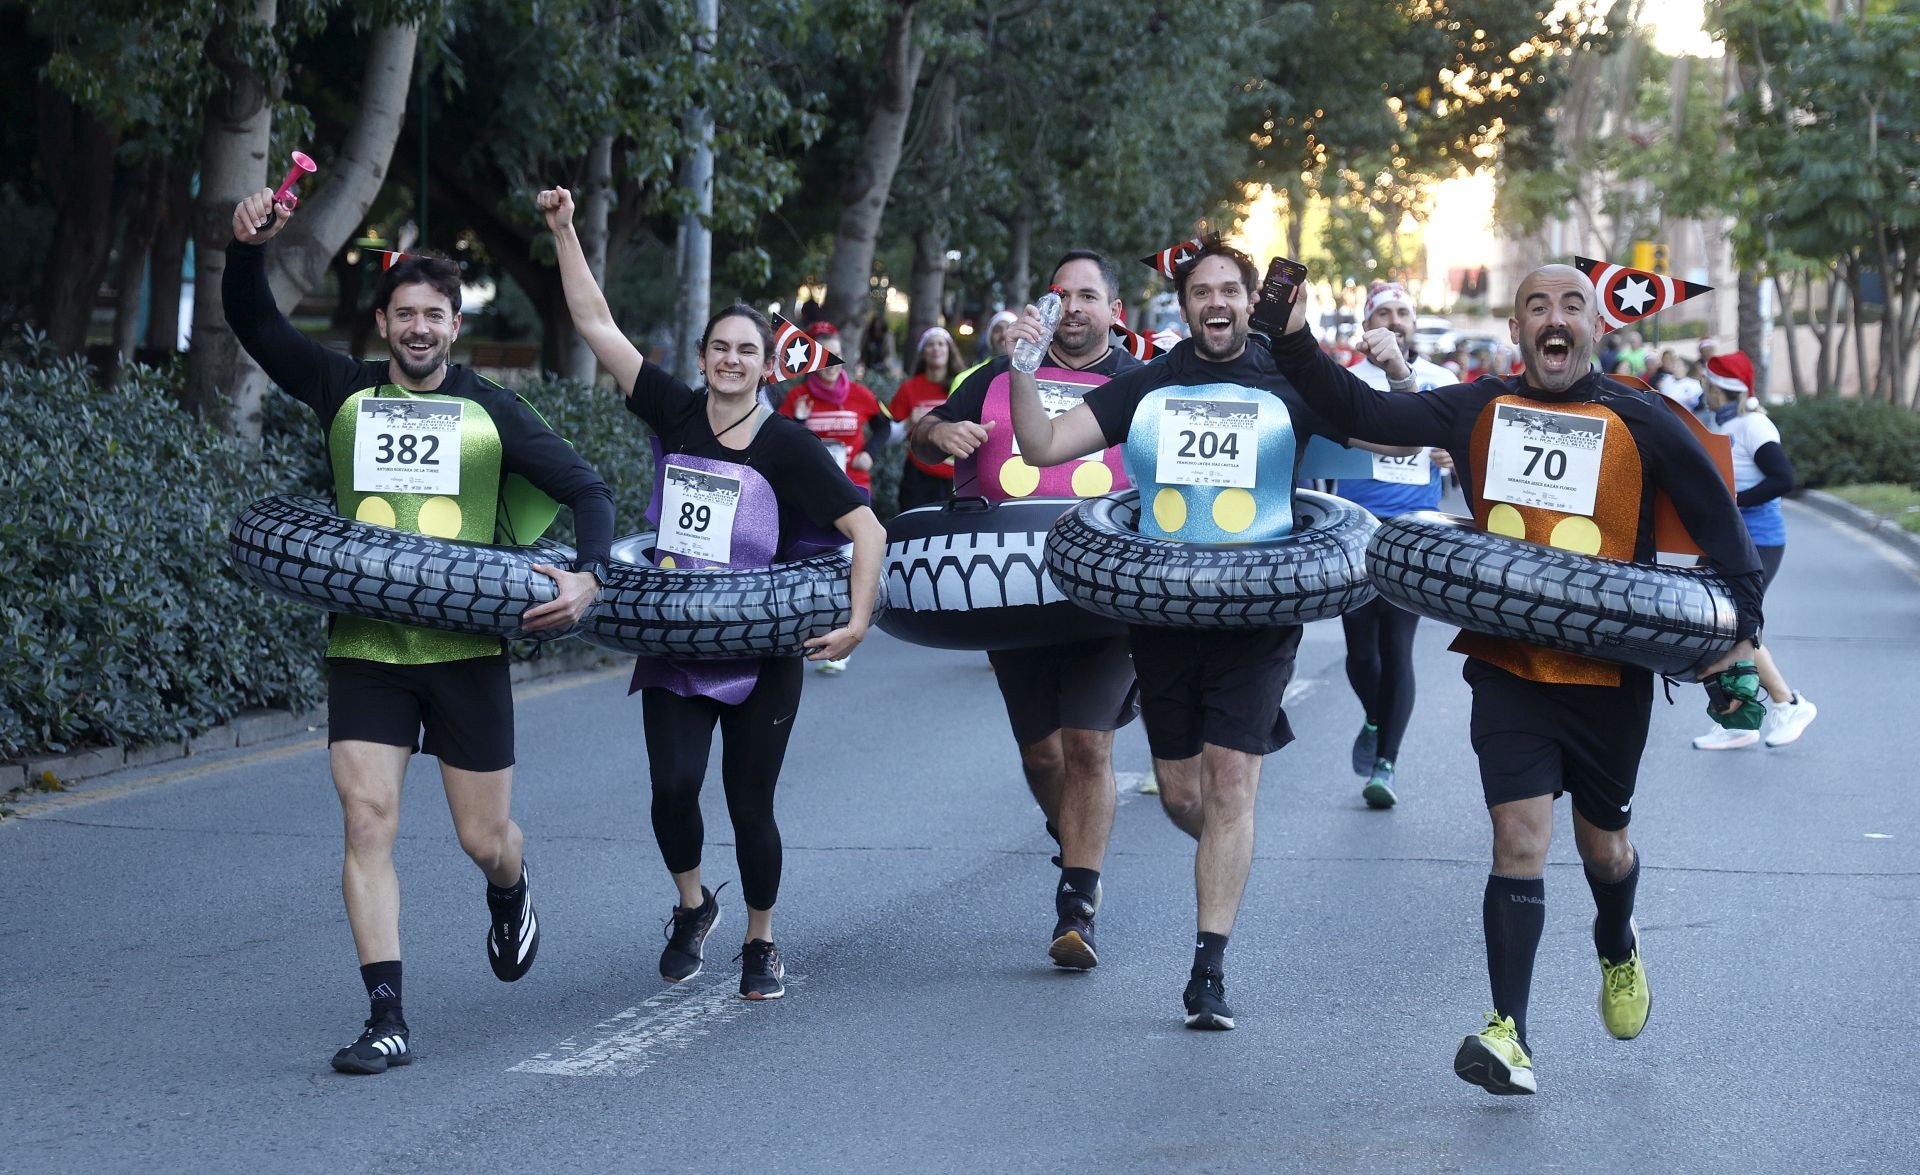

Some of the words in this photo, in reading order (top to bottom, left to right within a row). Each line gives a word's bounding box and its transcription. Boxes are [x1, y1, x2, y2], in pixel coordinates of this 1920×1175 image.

[375, 433, 440, 465] 382
[1177, 429, 1239, 460] 204
[1522, 445, 1567, 481] 70
[678, 502, 711, 532] 89
